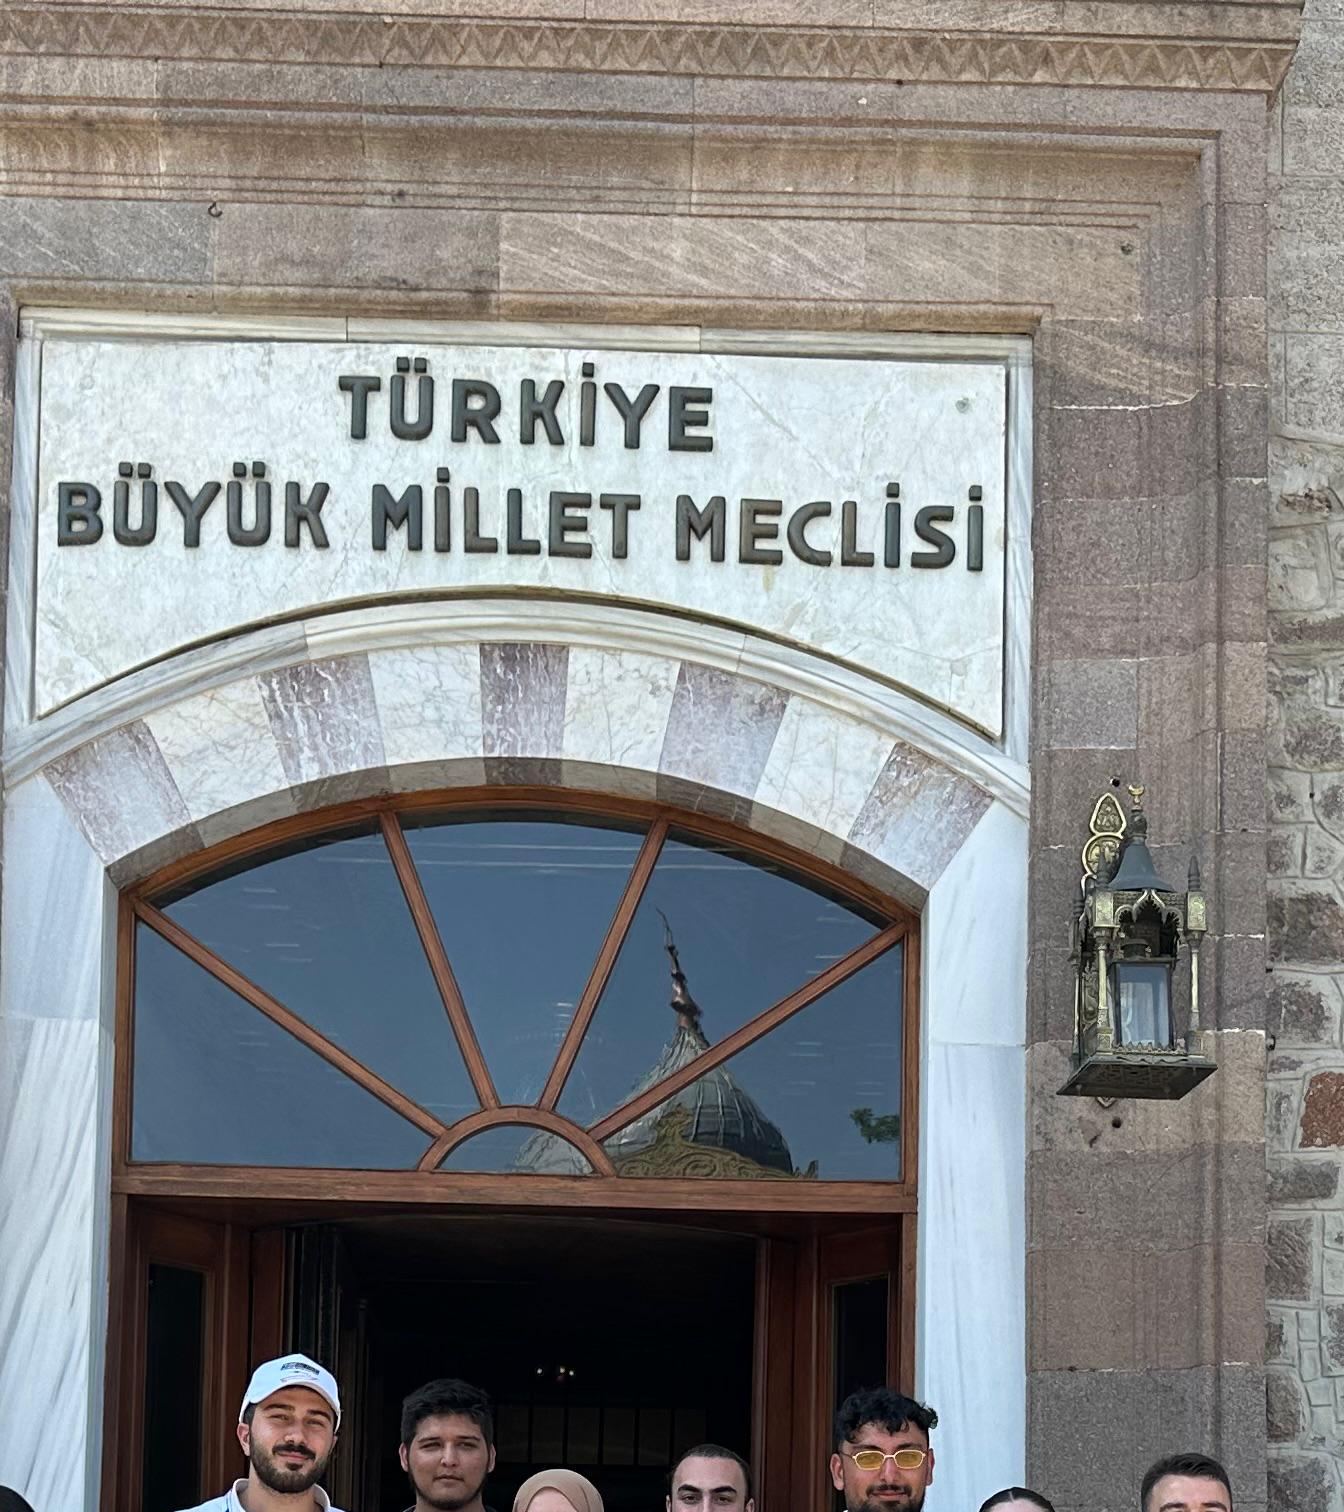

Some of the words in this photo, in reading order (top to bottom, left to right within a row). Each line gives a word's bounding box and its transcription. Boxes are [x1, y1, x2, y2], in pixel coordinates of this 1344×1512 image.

[339, 357, 713, 452] TÜRKİYE
[57, 461, 330, 548] BÜYÜK
[372, 467, 641, 559] MİLLET
[675, 482, 984, 572] MECLİSİ
